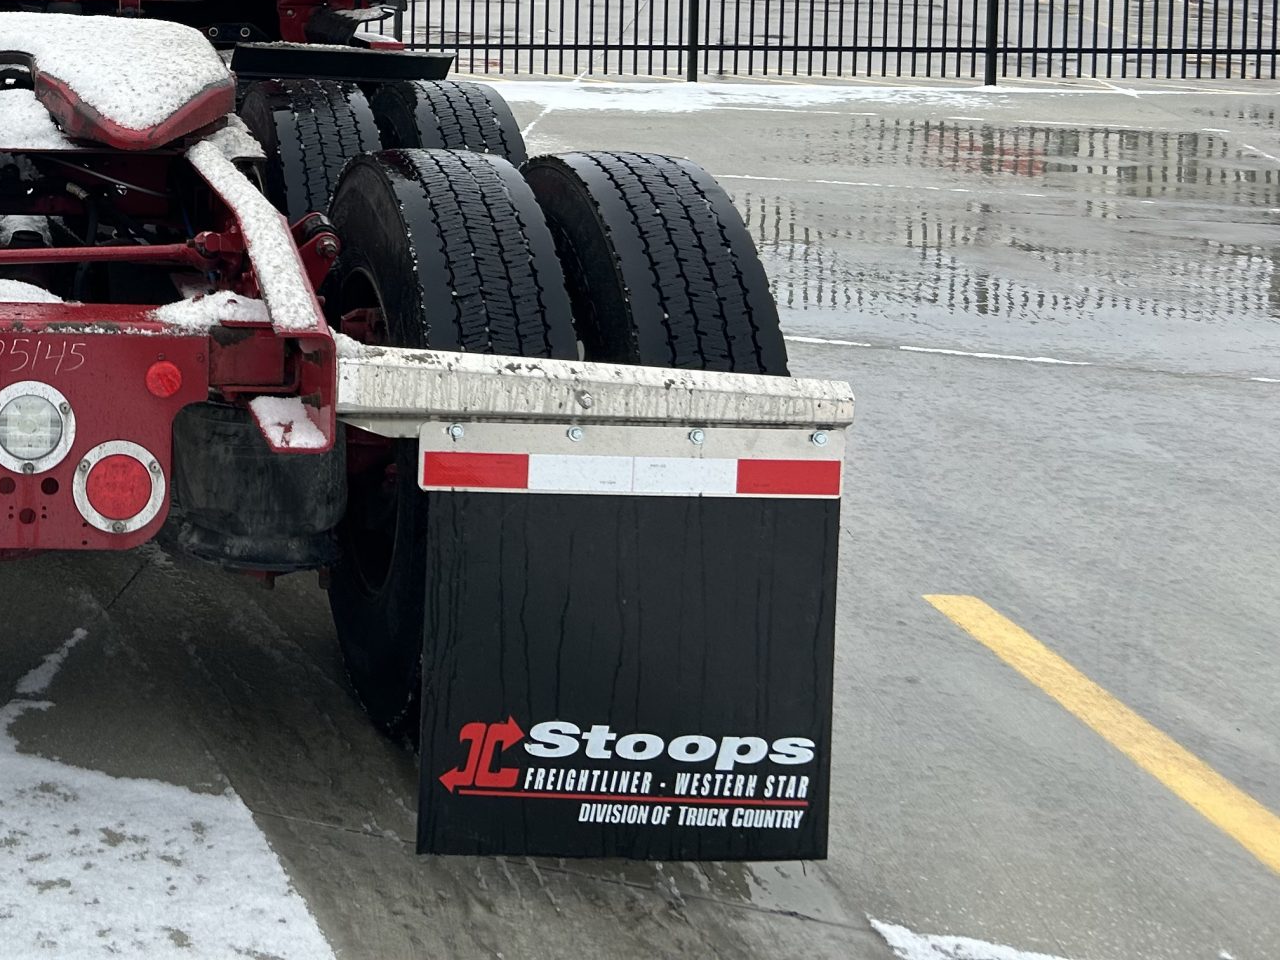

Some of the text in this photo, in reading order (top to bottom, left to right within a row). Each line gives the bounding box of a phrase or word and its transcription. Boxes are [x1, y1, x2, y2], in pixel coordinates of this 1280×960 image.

[524, 722, 816, 770] Stoops
[524, 768, 652, 793] FREIGHTLINER
[675, 773, 757, 797] WESTERN
[764, 775, 809, 798] STAR
[579, 804, 803, 829] DIVISION OF TRUCK COUNTRY
